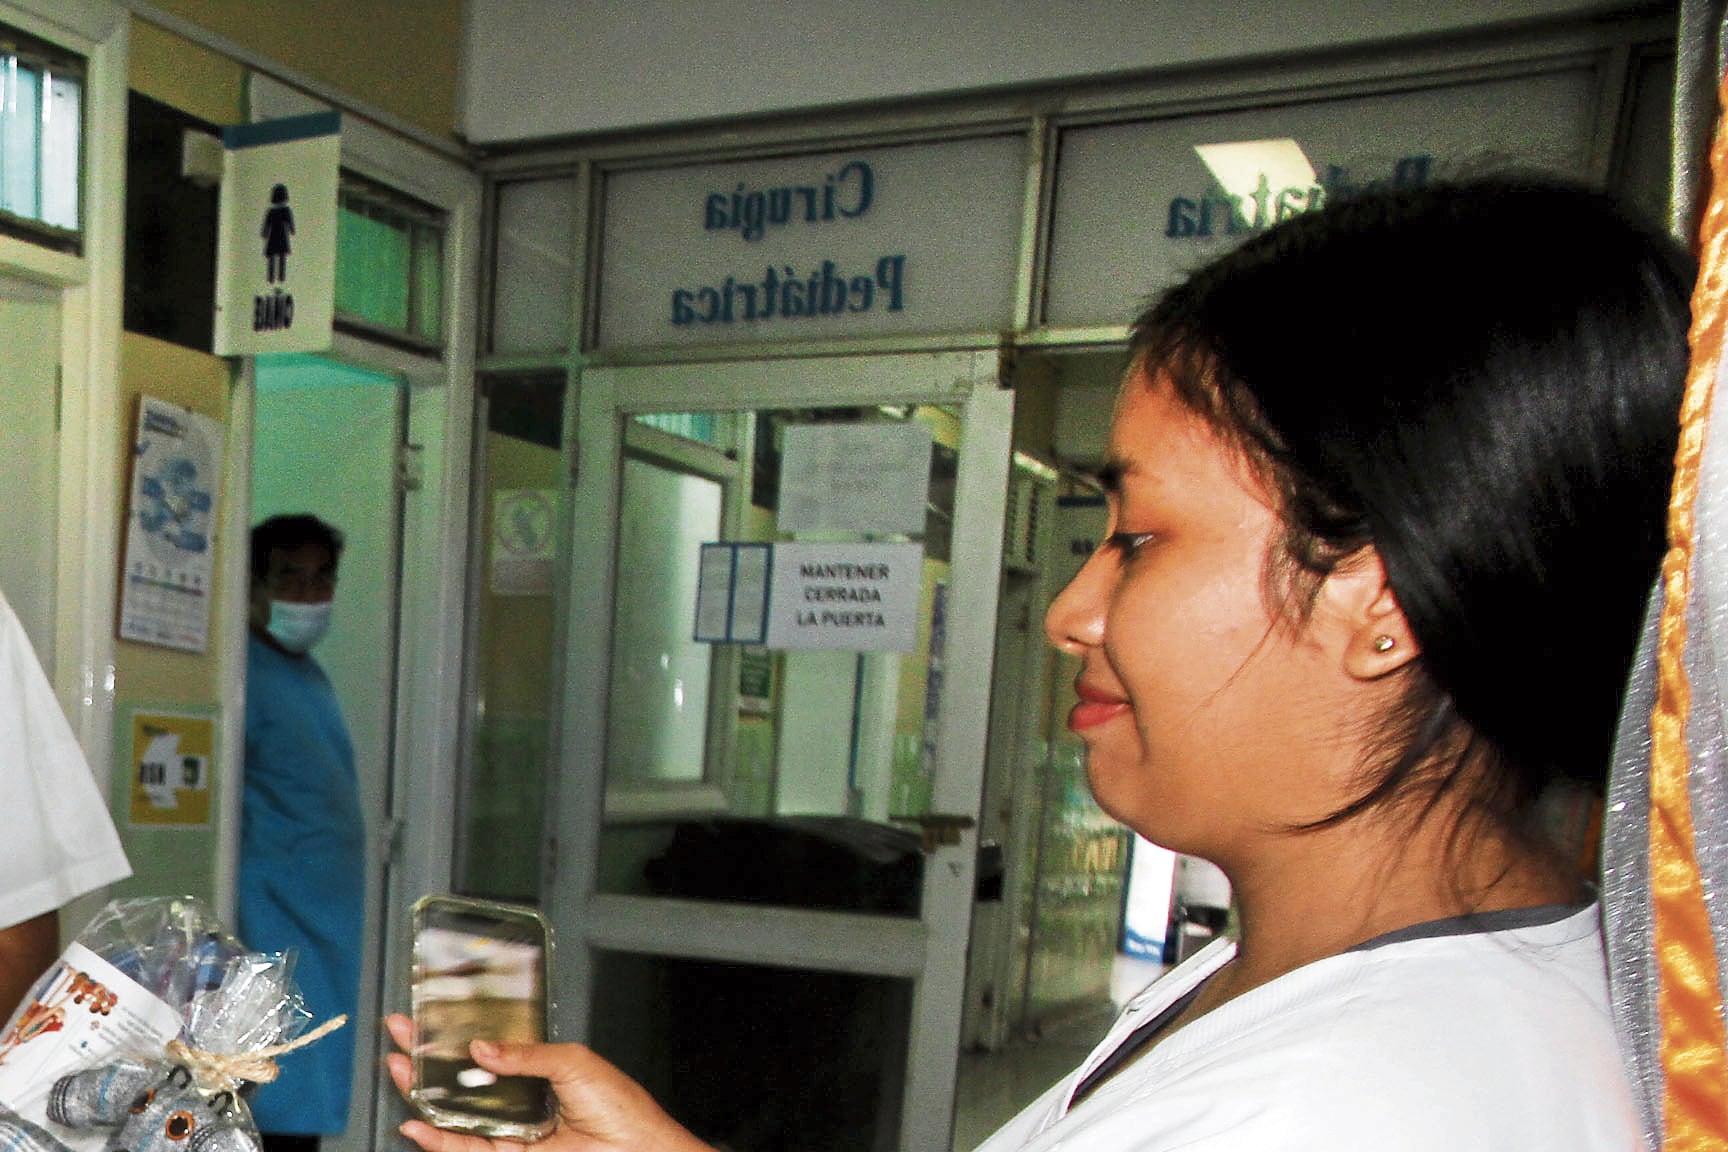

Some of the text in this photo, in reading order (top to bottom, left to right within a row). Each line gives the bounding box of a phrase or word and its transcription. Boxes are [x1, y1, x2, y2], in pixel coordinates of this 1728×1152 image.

[253, 287, 293, 331] BAÑO
[799, 562, 890, 580] MANTENER
[804, 586, 881, 603] CERRADA
[797, 610, 885, 627] LA PUERTA
